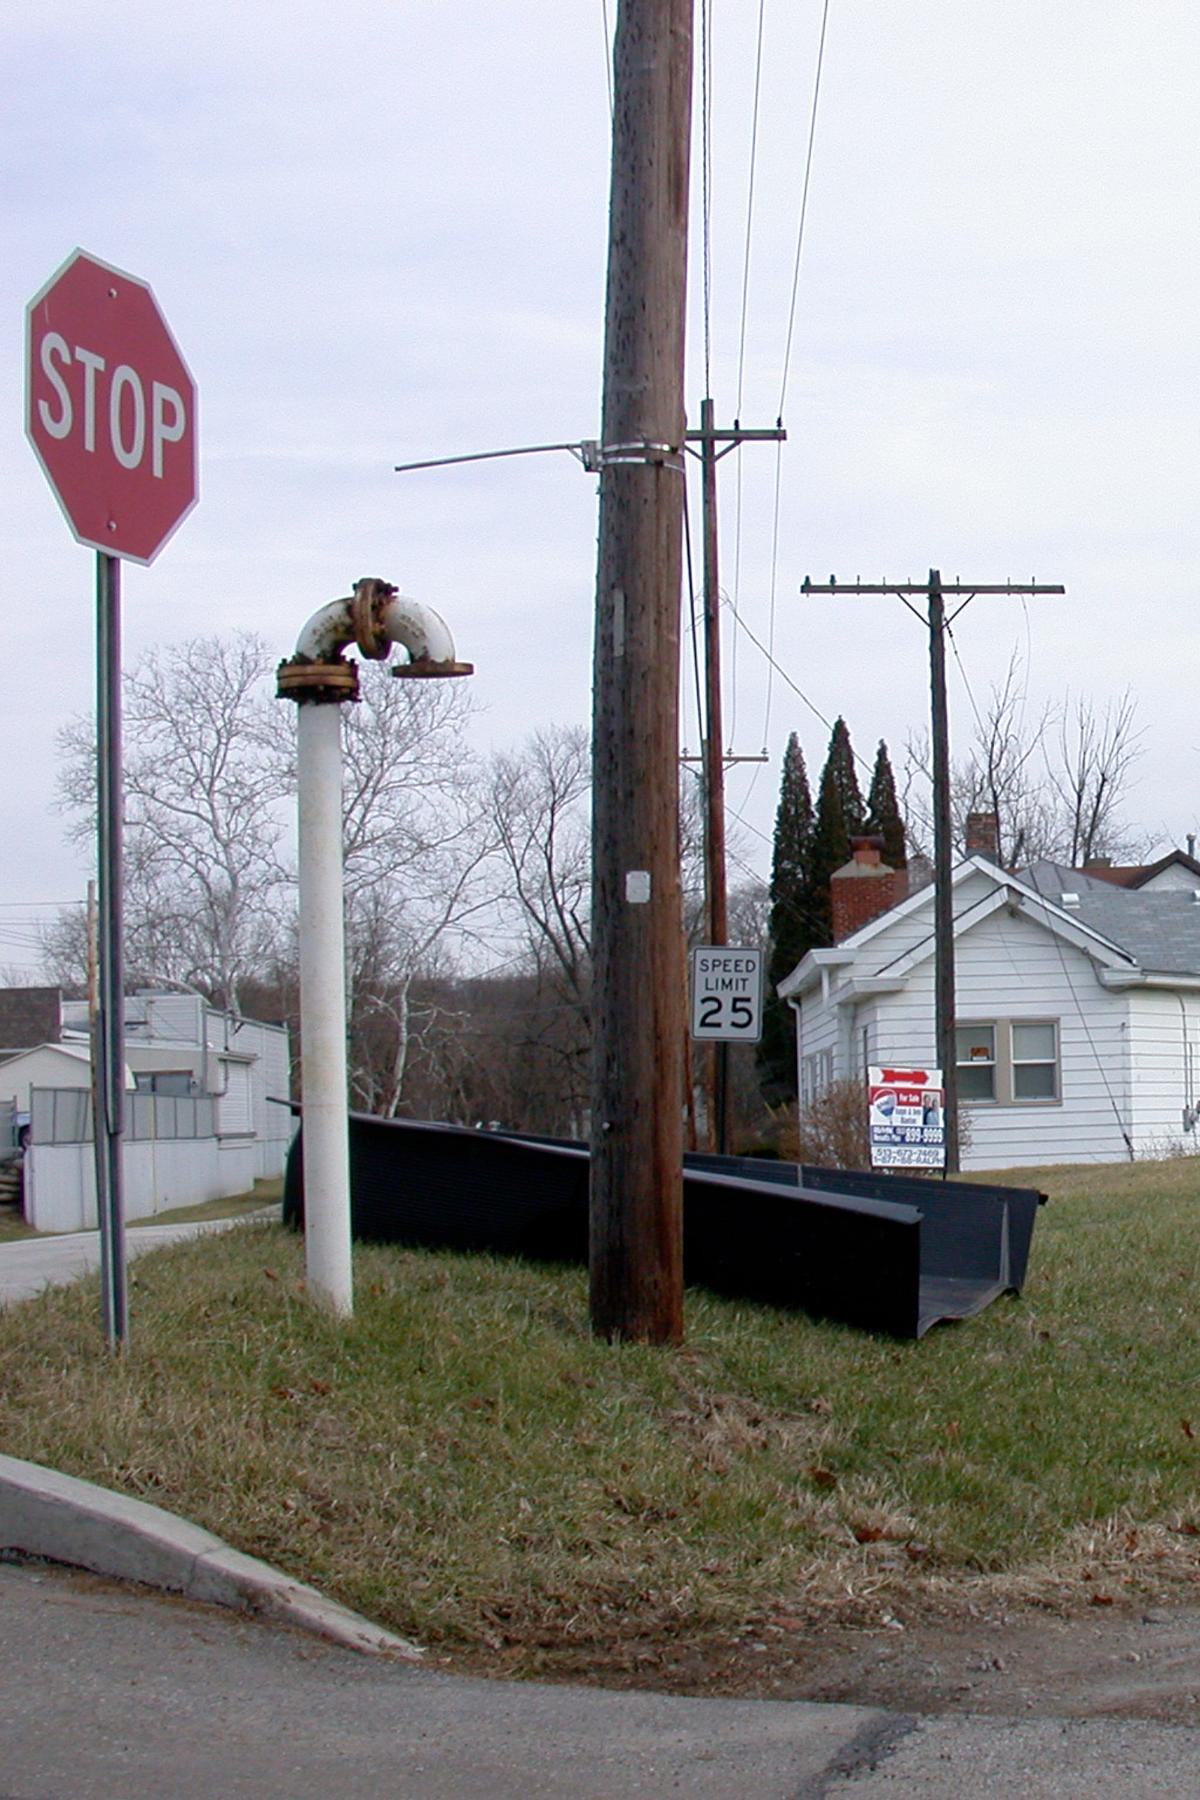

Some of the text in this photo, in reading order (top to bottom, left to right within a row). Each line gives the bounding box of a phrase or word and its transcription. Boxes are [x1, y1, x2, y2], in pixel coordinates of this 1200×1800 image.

[38, 331, 187, 479] STOP
[699, 959, 756, 973] SPEED
[705, 977, 749, 991] LIMIT
[699, 996, 753, 1029] 25
